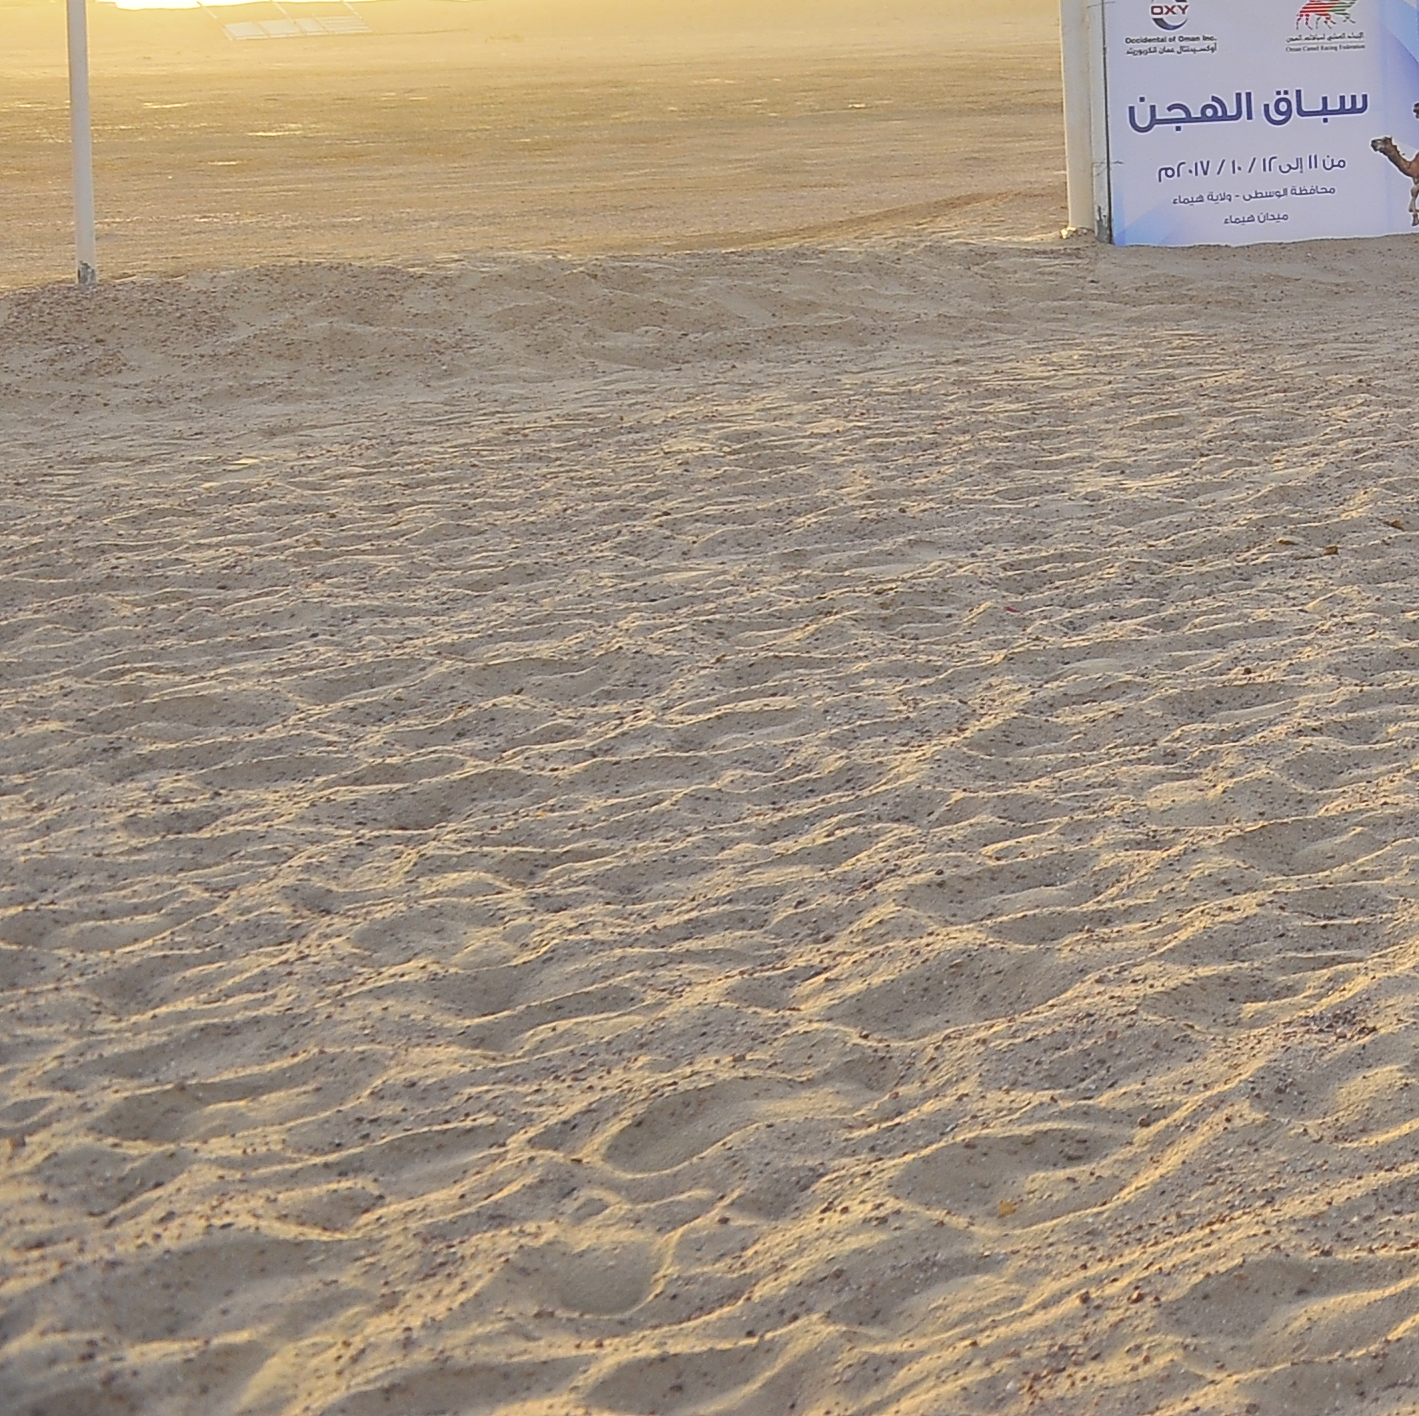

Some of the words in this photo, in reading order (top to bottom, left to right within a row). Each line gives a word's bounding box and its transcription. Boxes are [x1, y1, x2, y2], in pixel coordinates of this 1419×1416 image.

[1150, 5, 1189, 15] OXY
[1125, 35, 1167, 44] Occidental
[1168, 35, 1176, 43] of
[1178, 35, 1200, 43] Oman
[1202, 34, 1217, 42] Inc.
[1128, 91, 1253, 133] الهجن
[1263, 89, 1368, 126] سباق
[1322, 155, 1346, 171] من
[1242, 187, 1288, 202] الوسطى
[1290, 185, 1336, 196] محافظة
[1172, 194, 1204, 207] هيماء
[1207, 191, 1232, 205] ولاية
[1223, 214, 1255, 226] هيماء
[1257, 212, 1289, 224] ميدان
